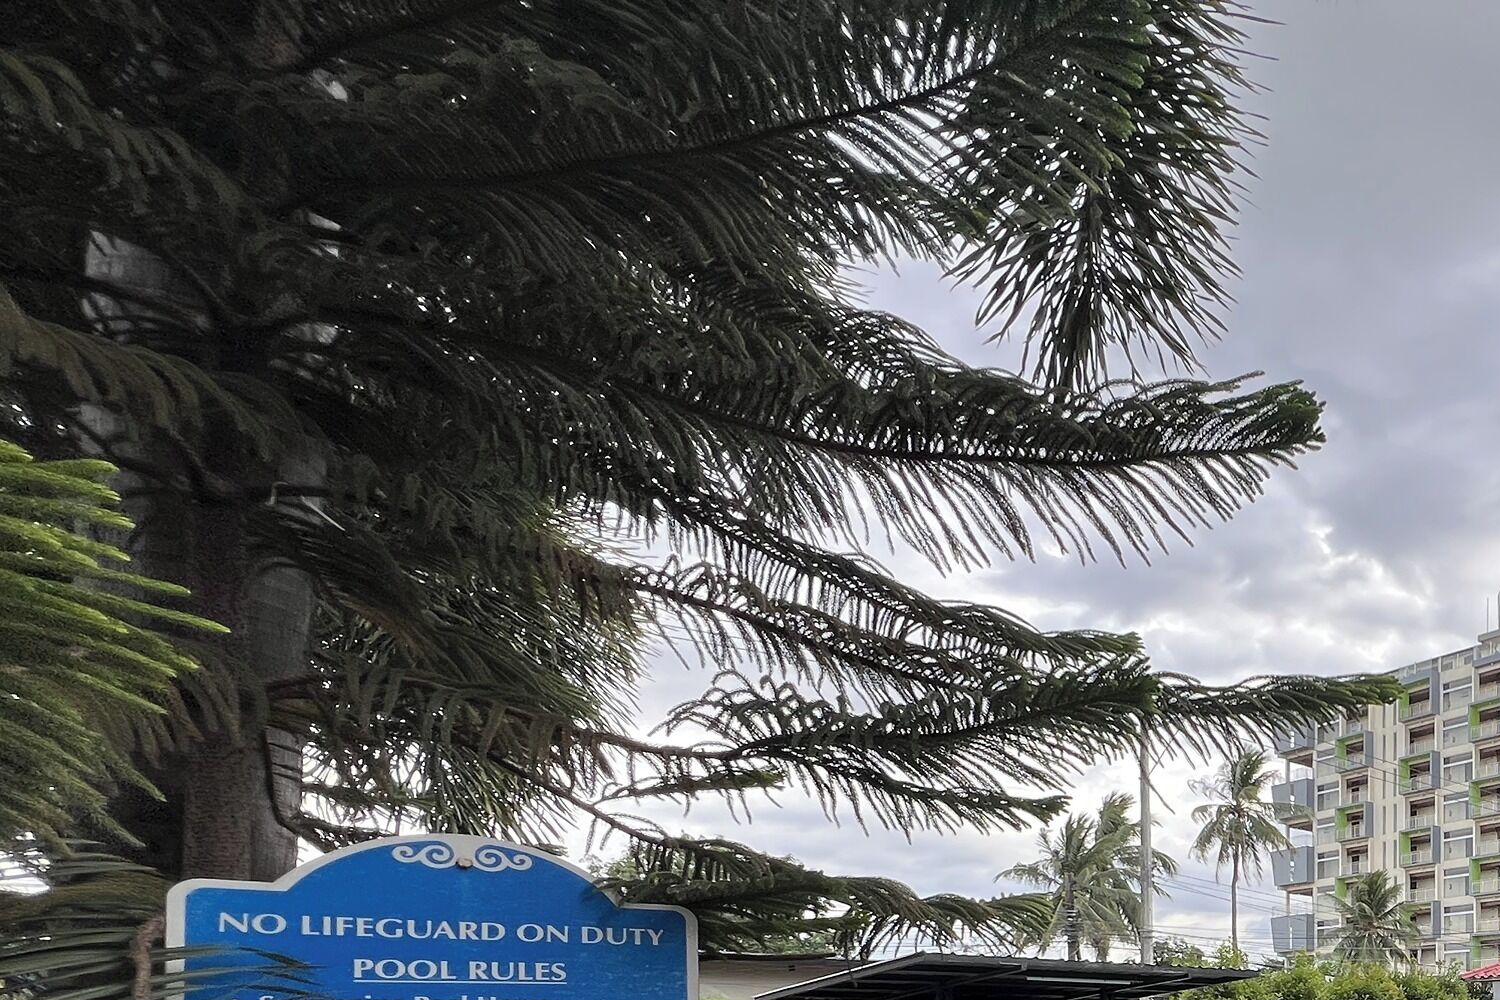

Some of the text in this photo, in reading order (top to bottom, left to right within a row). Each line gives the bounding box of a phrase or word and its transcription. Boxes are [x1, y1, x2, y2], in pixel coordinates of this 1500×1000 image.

[218, 911, 664, 947] NO LIFEGUARD ON DUTY
[353, 958, 567, 982] POOL RULES
